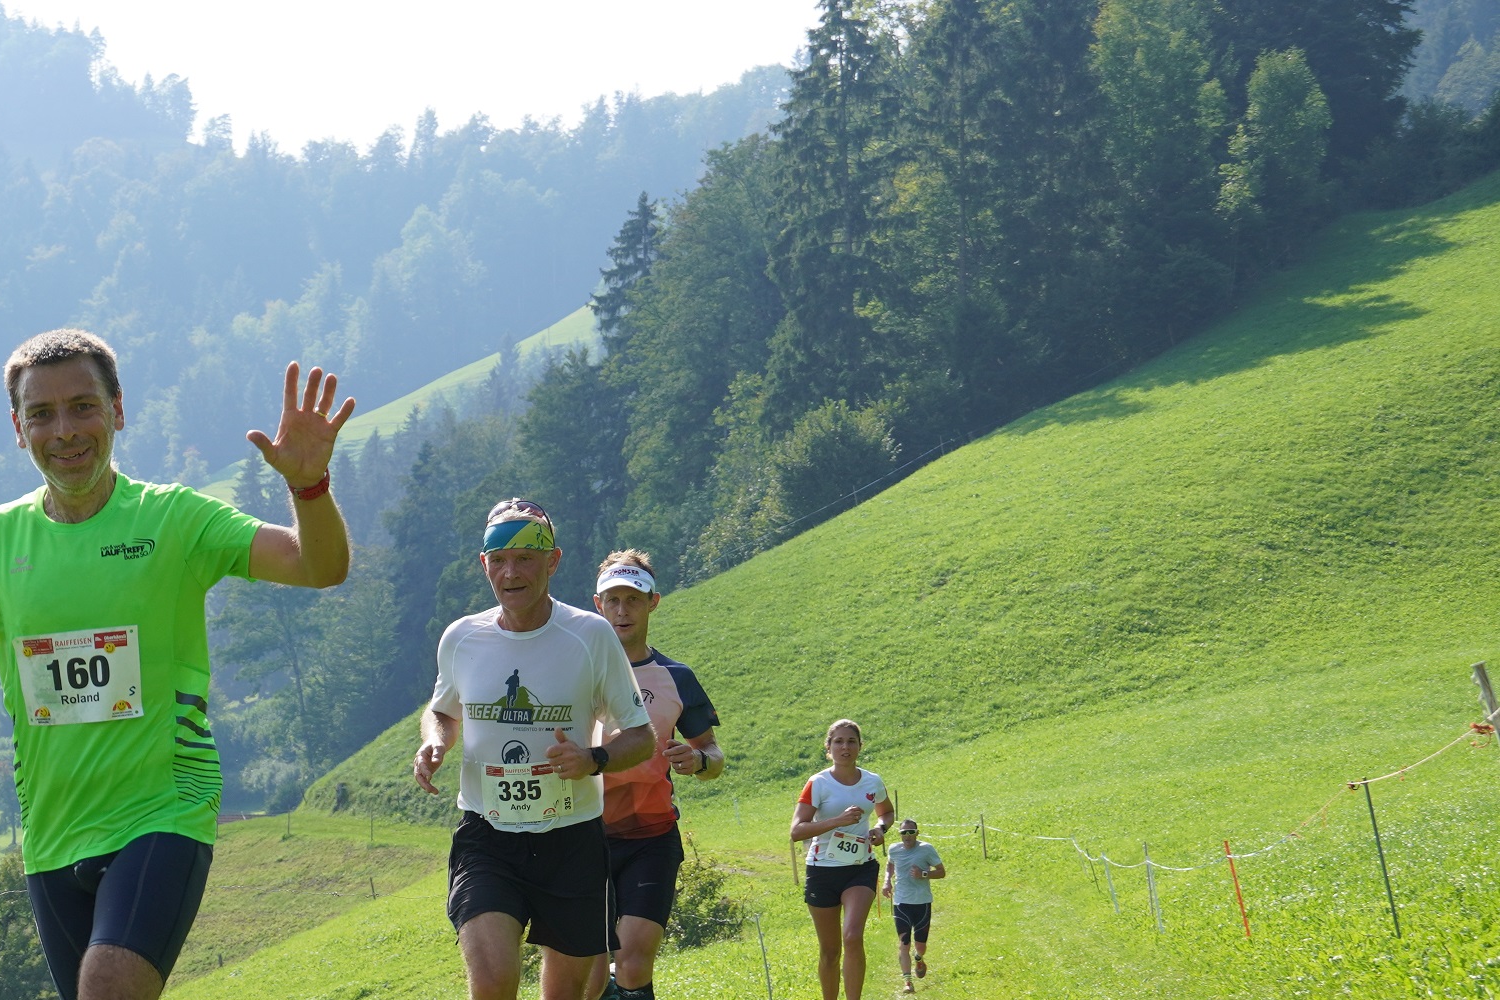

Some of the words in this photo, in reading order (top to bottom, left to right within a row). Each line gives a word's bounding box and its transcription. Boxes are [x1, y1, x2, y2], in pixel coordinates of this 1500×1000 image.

[100, 545, 145, 557] LAUF-TREFF
[54, 637, 92, 647] RAIFFEISEN
[46, 655, 110, 691] 160
[60, 692, 100, 705] Roland
[466, 705, 502, 719] EIGER
[502, 710, 529, 721] ULTRA
[532, 706, 572, 721] TRAIL
[498, 779, 542, 802] 335
[510, 803, 531, 811] Andy
[564, 796, 572, 810] 335
[837, 840, 859, 854] 430
